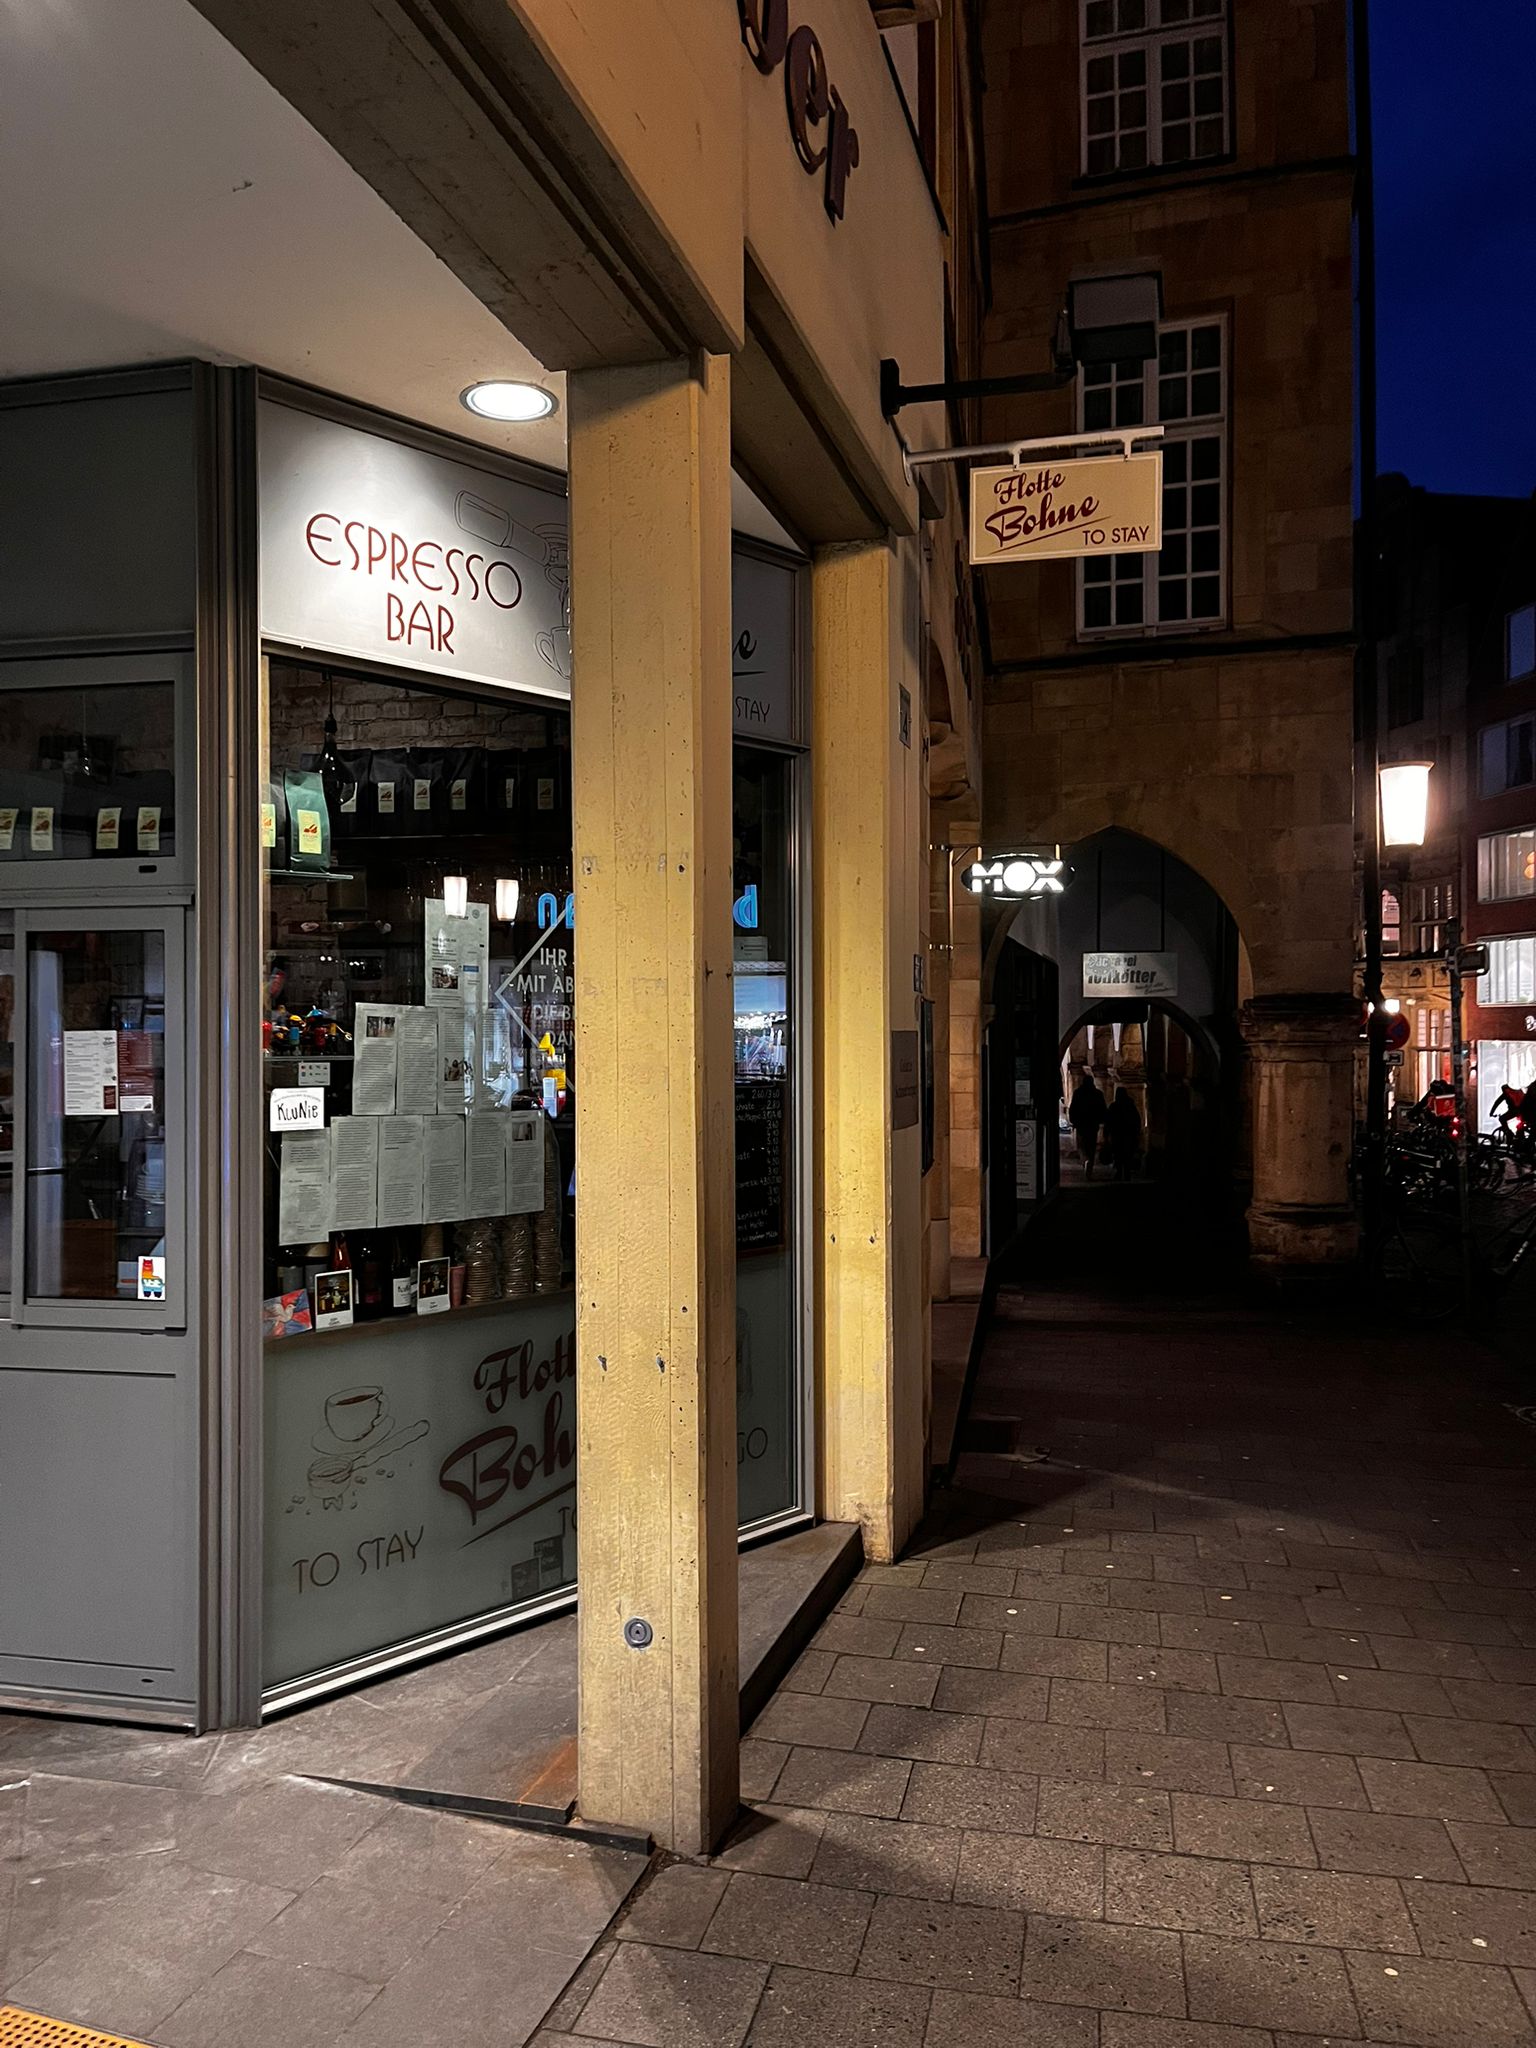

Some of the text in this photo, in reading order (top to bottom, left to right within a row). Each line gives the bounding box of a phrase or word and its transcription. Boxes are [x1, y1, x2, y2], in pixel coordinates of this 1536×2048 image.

[993, 469, 1066, 504] Flotte
[985, 492, 1100, 547] Bohne
[1083, 525, 1150, 546] TO STAY
[306, 513, 522, 609] ESPRESSO
[387, 592, 455, 655] BAR
[735, 696, 770, 723] STAY
[971, 860, 1065, 893] MOX
[540, 947, 568, 967] IHR
[516, 974, 547, 994] MIT
[473, 1330, 577, 1414] Flott
[439, 1390, 577, 1526] Boh
[291, 1525, 424, 1594] TO STAY
